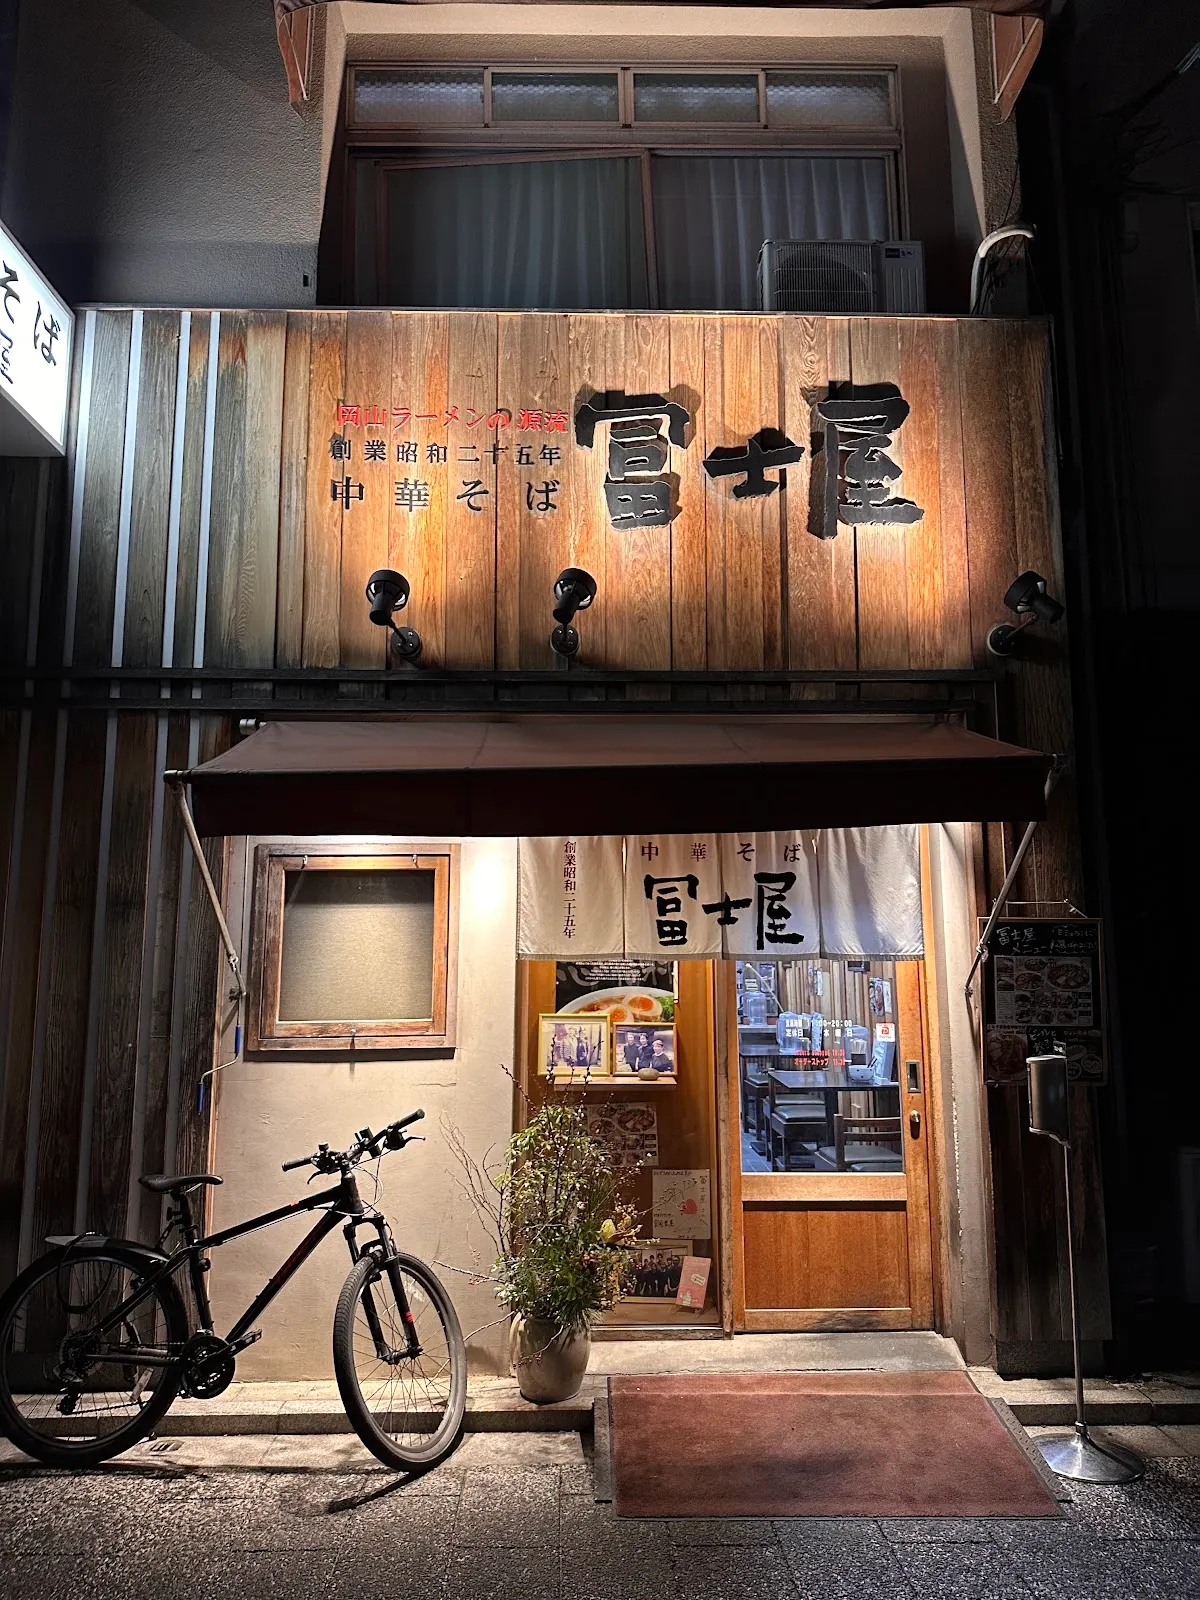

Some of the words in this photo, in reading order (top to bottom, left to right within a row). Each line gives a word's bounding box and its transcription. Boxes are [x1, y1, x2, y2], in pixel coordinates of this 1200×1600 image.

[336, 404, 570, 433] 岡山ラーメンの源流
[329, 438, 562, 466] 創業昭和二十五年
[330, 475, 561, 513] 中華そば
[640, 841, 801, 863] 中華そば
[562, 840, 577, 940] 創業昭和二十五年
[785, 1029, 803, 1037] 定休日
[794, 1057, 829, 1066] オーダーストップ
